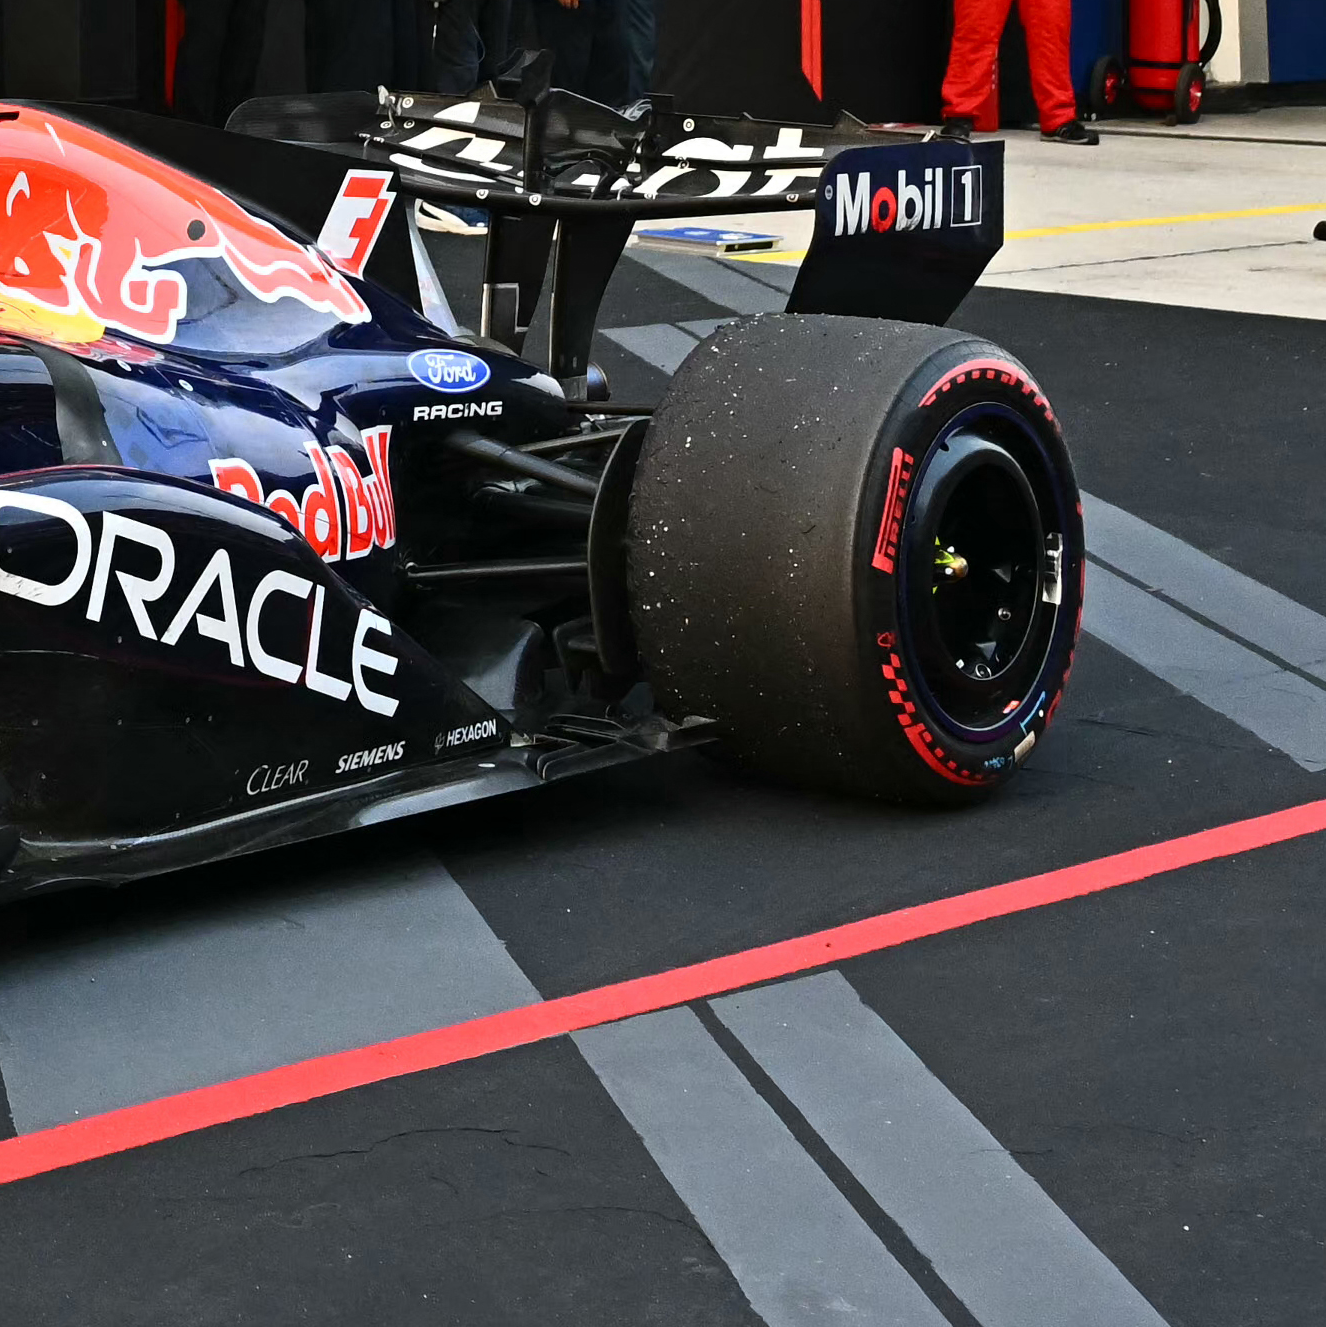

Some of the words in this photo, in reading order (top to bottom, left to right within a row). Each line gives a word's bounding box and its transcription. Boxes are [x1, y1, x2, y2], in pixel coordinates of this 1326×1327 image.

[834, 168, 943, 237] Mobil
[424, 353, 477, 383] Ford
[413, 401, 503, 421] RACING
[325, 424, 396, 561] Bull
[871, 447, 914, 574] PIRELLI
[446, 719, 497, 747] HEXAGON
[335, 740, 406, 774] SIEMENS
[247, 758, 309, 796] CLEAR
